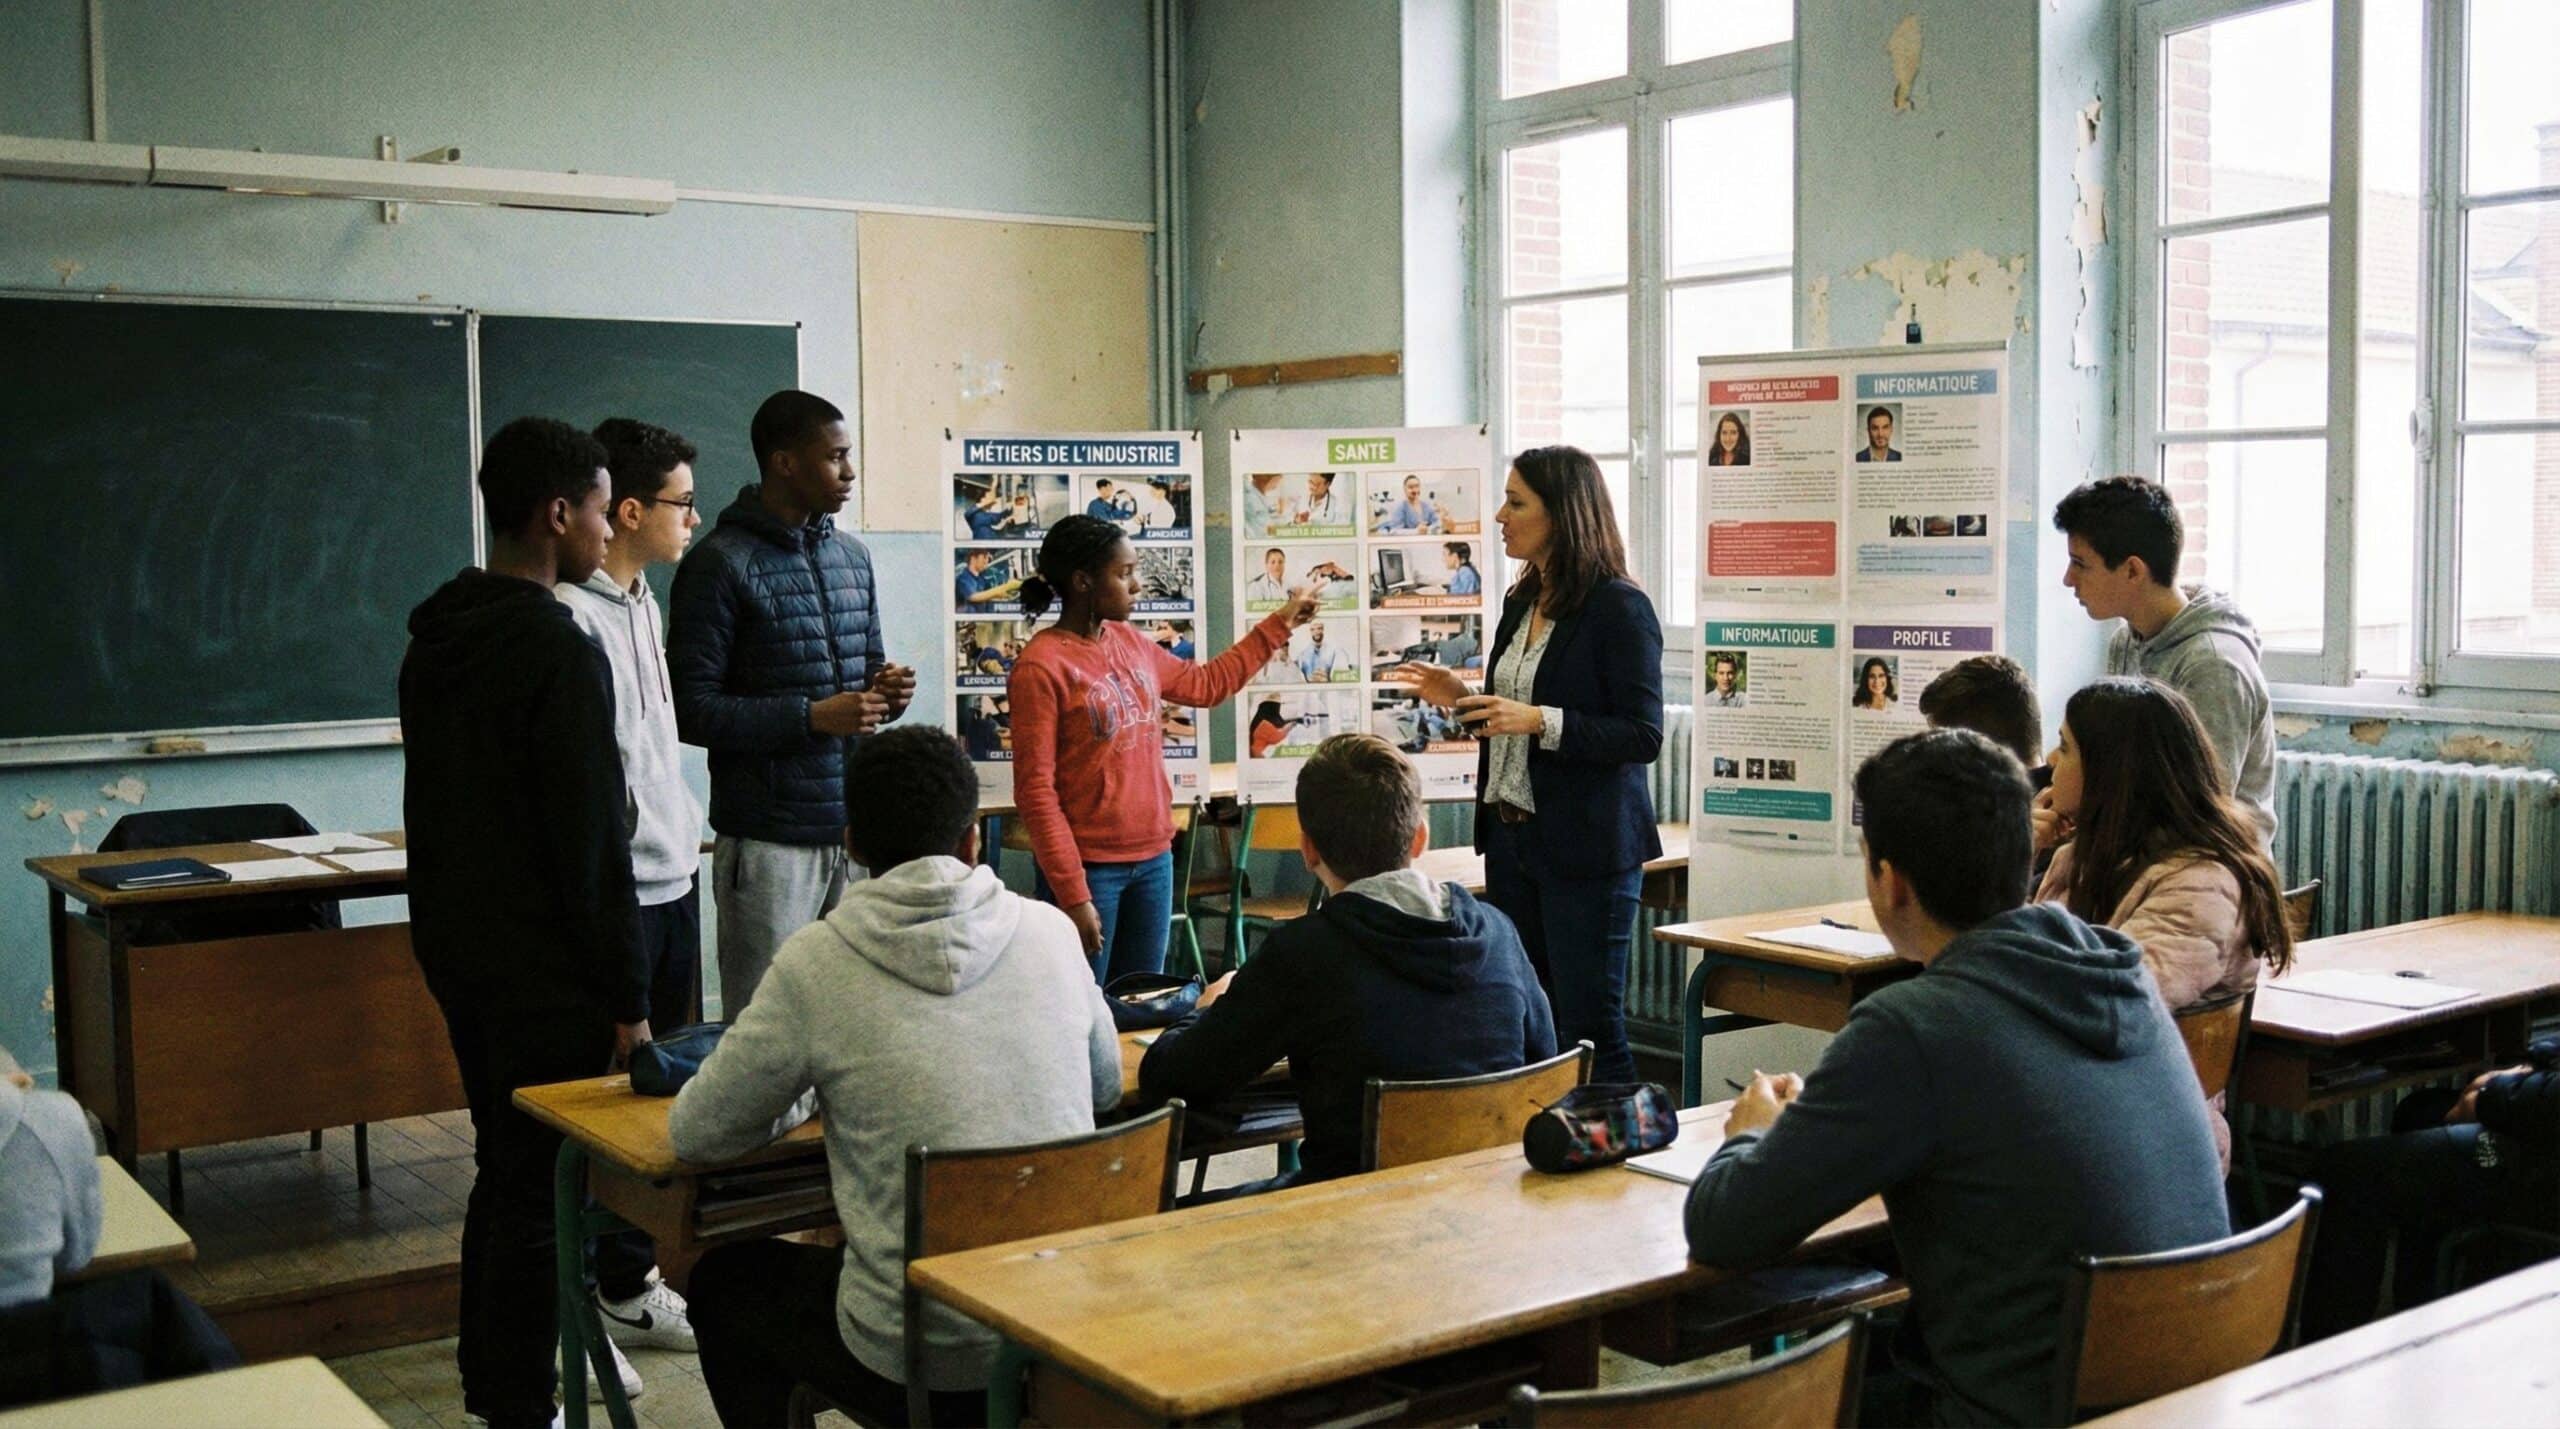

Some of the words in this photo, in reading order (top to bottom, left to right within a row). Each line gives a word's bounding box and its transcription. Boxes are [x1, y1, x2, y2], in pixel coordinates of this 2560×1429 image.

[1874, 374, 1979, 394] INFORMATIQUE
[970, 440, 1043, 463] MÉTIERS
[1047, 444, 1069, 463] DE
[1073, 445, 1175, 463] L'INDUSTRIE
[1335, 442, 1390, 462] SANTE
[1721, 627, 1819, 644] INFORMATIQUE
[1893, 630, 1952, 647] PROFILE
